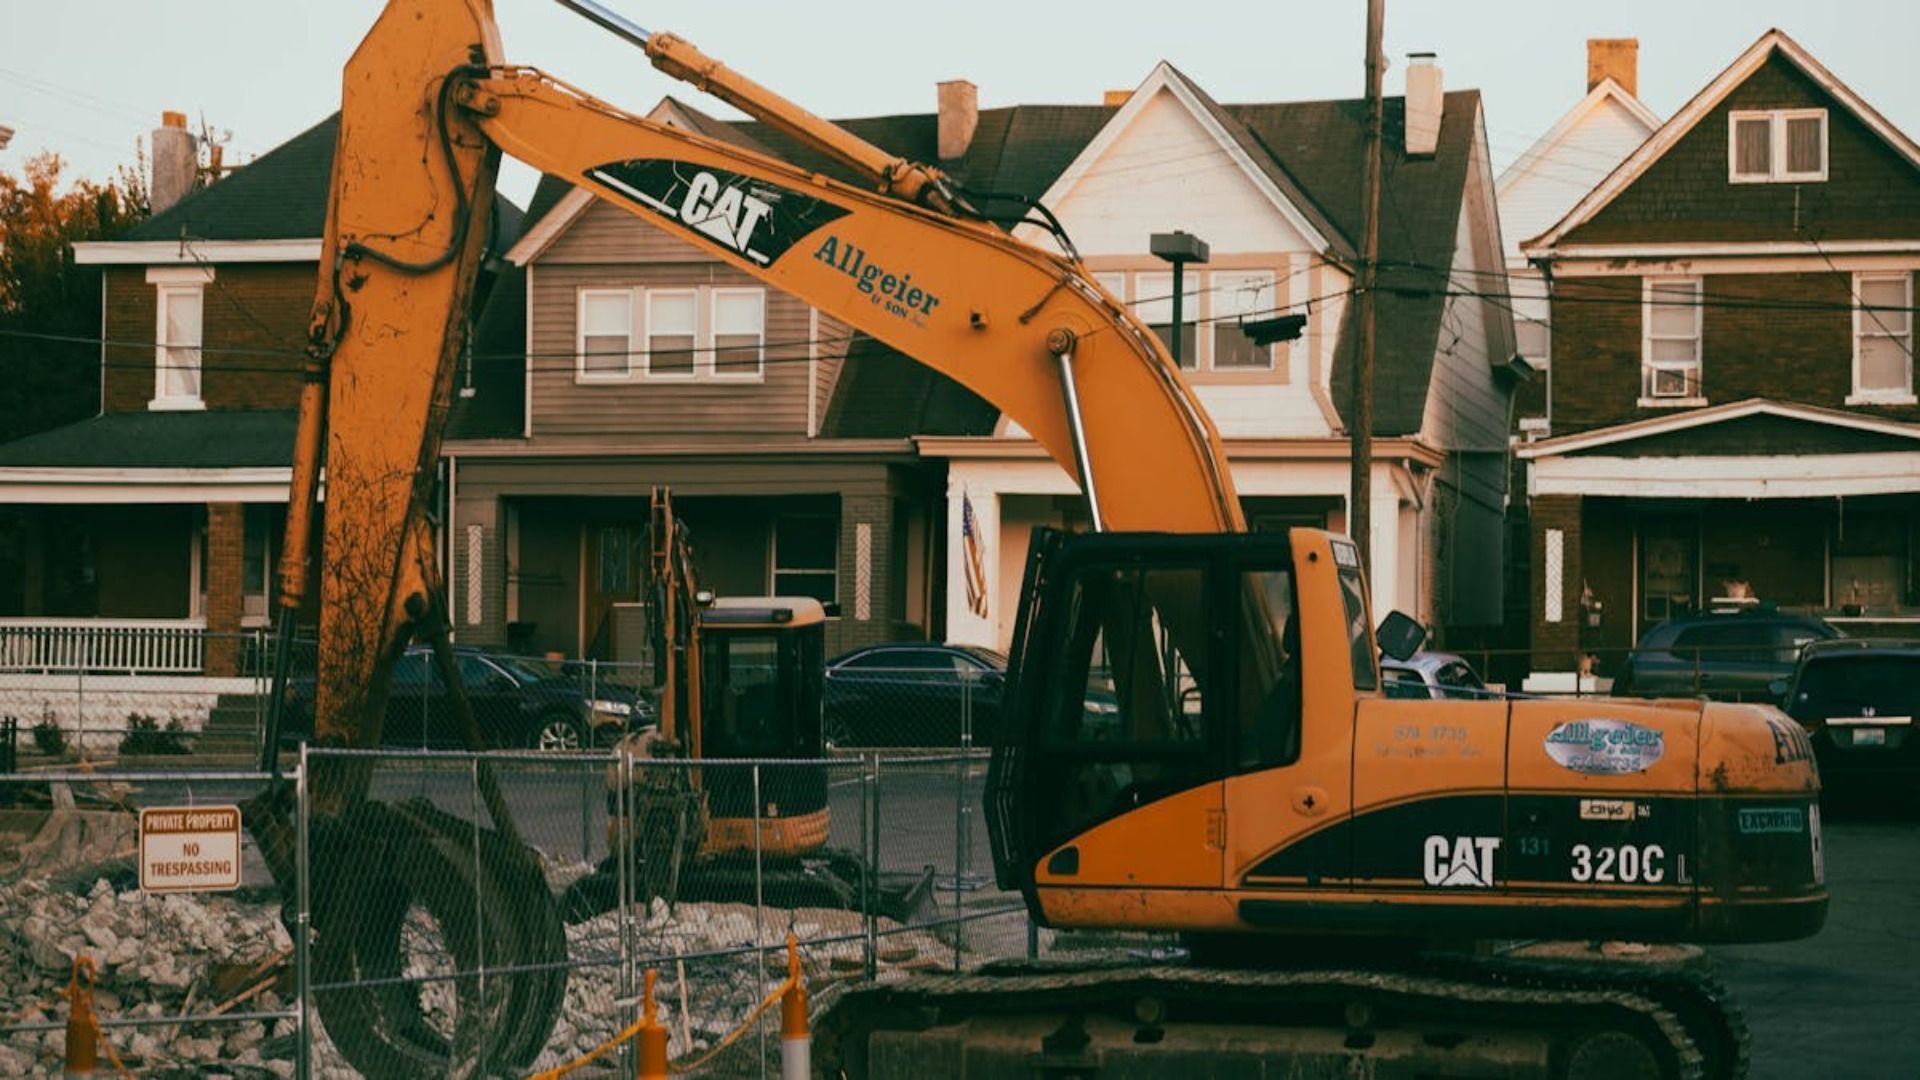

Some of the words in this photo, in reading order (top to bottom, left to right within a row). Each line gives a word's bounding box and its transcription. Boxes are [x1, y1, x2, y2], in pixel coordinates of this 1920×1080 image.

[681, 171, 770, 251] CAT
[814, 235, 939, 316] Allgeier
[146, 814, 184, 831] PRIVATE
[186, 813, 235, 829] PROPERTY
[183, 843, 199, 856] NO
[1520, 837, 1549, 855] 131
[151, 861, 231, 877] TRESPASSING
[1423, 834, 1500, 887] CAT
[1571, 844, 1664, 883] 320C
